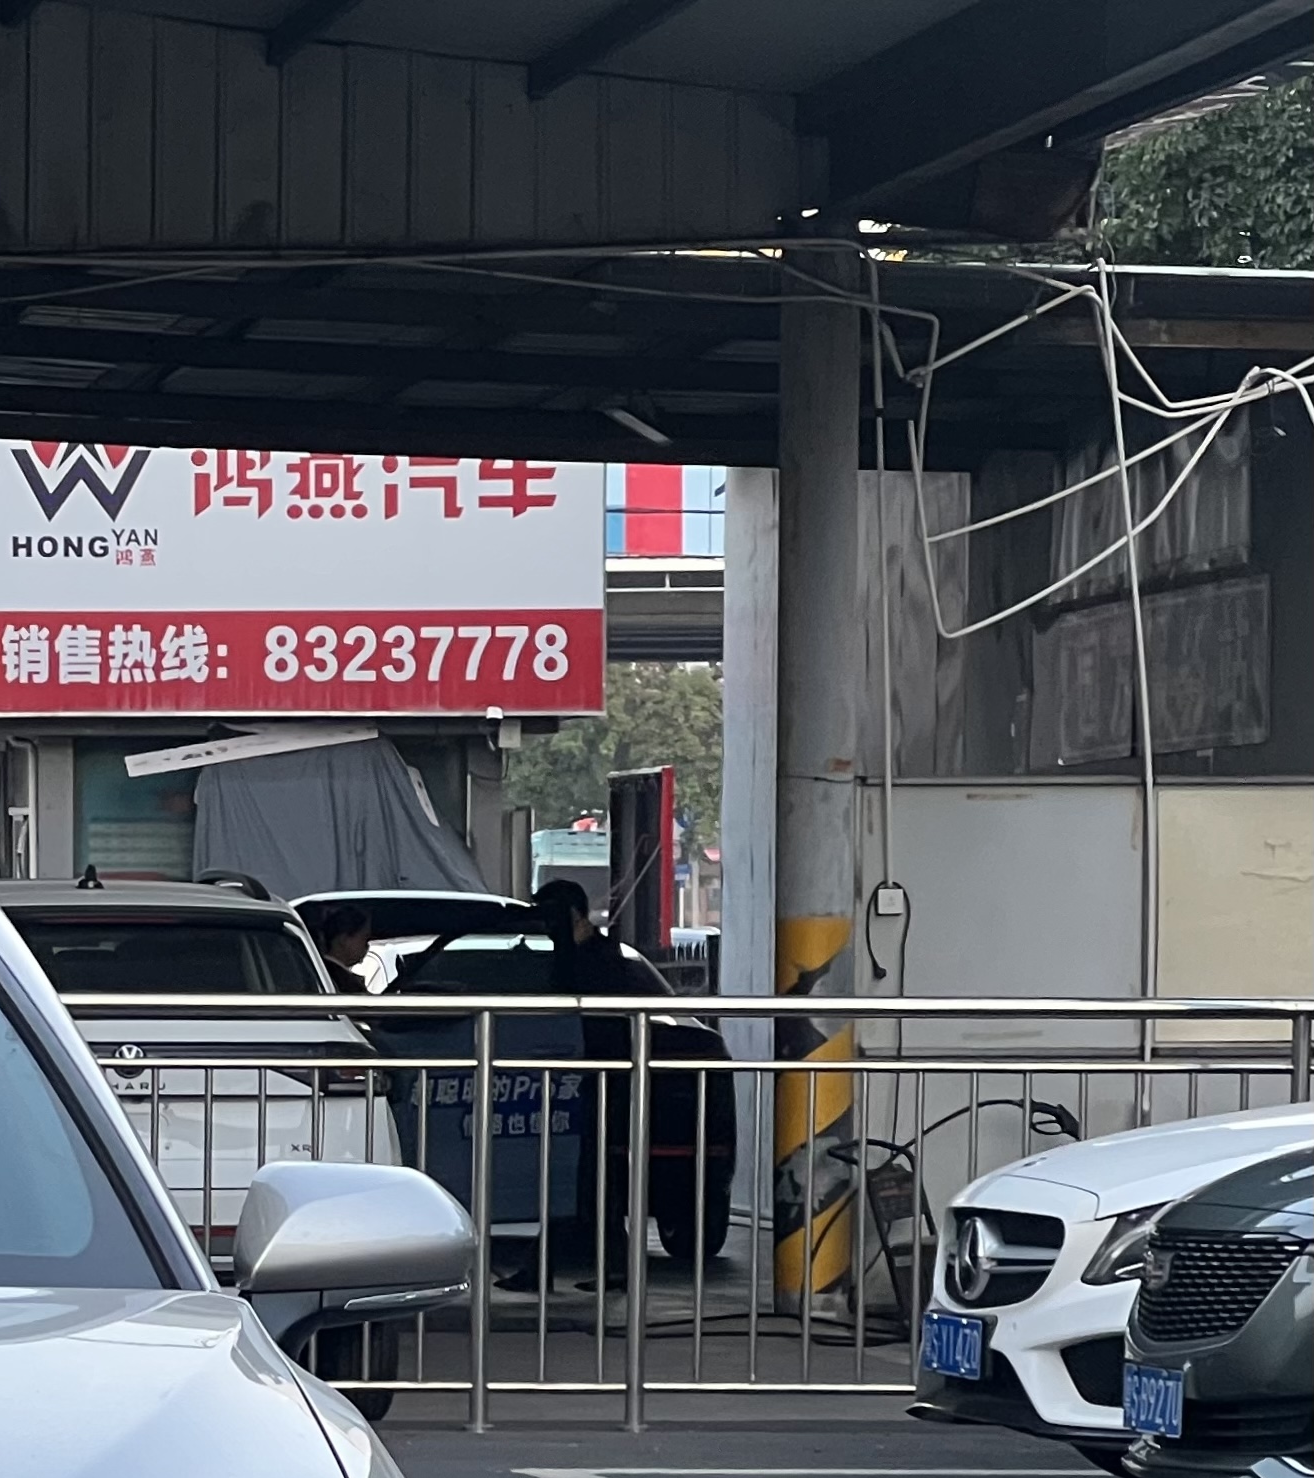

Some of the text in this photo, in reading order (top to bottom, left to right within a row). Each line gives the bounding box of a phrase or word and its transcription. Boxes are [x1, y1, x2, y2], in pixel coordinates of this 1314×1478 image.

[191, 449, 557, 519] 鸿燕汽车
[115, 549, 157, 566] 鸿燕
[263, 624, 569, 683] 83237778
